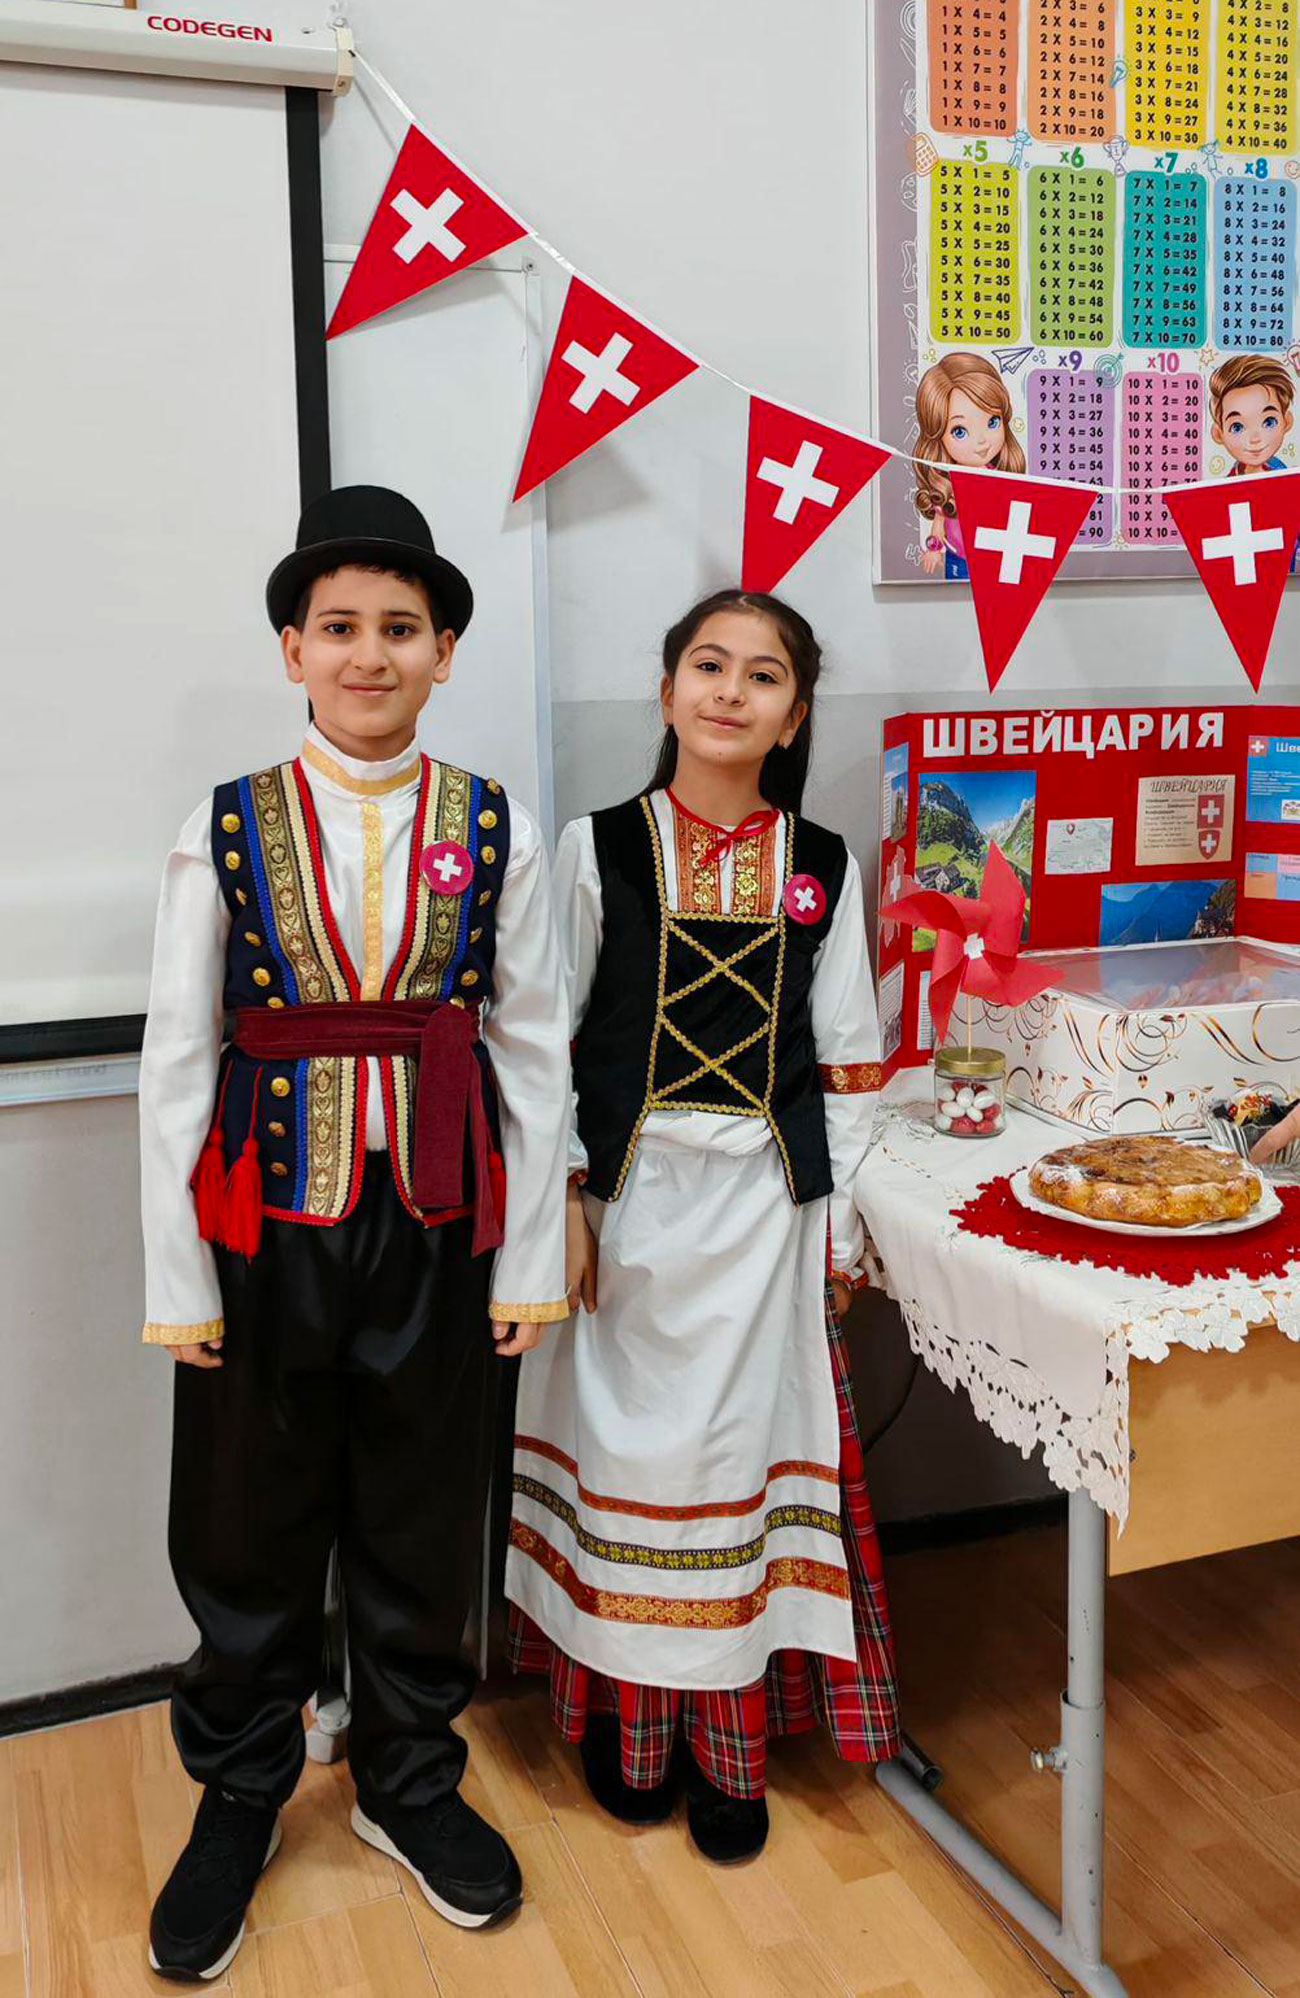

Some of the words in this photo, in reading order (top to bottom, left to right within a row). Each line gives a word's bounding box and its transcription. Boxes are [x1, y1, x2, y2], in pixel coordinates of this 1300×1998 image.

[147, 15, 273, 42] CODEGEN
[1228, 15, 1234, 25] 4
[1255, 17, 1261, 28] 3
[1276, 20, 1288, 30] 12
[973, 27, 980, 38] 5
[1000, 29, 1006, 40] 5
[1136, 24, 1142, 34] 3
[1165, 27, 1172, 37] 4
[1187, 29, 1199, 40] 12
[1040, 33, 1047, 44] 2
[1070, 36, 1076, 46] 5
[1092, 38, 1104, 48] 10
[1227, 67, 1234, 77] 4
[1254, 69, 1260, 80] 6
[1274, 71, 1287, 81] 24
[974, 81, 980, 92] 8
[999, 83, 1006, 94] 8
[1136, 76, 1142, 87] 3
[1165, 79, 1172, 89] 7
[1186, 81, 1198, 92] 21
[1040, 87, 1047, 98] 2
[1069, 89, 1076, 100] 8
[1091, 91, 1104, 102] 16
[968, 118, 980, 128] 10
[995, 119, 998, 130] 10
[1040, 122, 1047, 133] 2
[1064, 124, 1076, 135] 10
[1090, 126, 1104, 137] 20
[1135, 129, 1141, 140] 3
[1160, 131, 1171, 142] 10
[1184, 132, 1198, 144] 30
[1226, 135, 1233, 146] 4
[1249, 137, 1260, 147] 10
[1274, 138, 1287, 149] 40
[941, 184, 947, 194] 5
[974, 186, 980, 196] 2
[997, 187, 1010, 198] 10
[1134, 195, 1141, 206] 7
[1164, 198, 1171, 208] 2
[1184, 198, 1198, 210] 14
[1040, 207, 1046, 218] 6
[1069, 209, 1075, 220] 3
[1091, 210, 1104, 221] 18
[1224, 217, 1231, 228] 8
[1252, 218, 1258, 229] 3
[1272, 220, 1285, 230] 24
[941, 237, 948, 248] 5
[974, 239, 980, 250] 5
[996, 240, 1010, 251] 25
[1040, 260, 1046, 270] 6
[1068, 261, 1075, 272] 6
[1090, 262, 1103, 273] 36
[1224, 268, 1230, 278] 8
[1251, 269, 1258, 279] 6
[1271, 270, 1284, 280] 48
[942, 290, 948, 300] 5
[974, 292, 980, 302] 8
[996, 292, 1010, 304] 40
[1133, 298, 1140, 309] 7
[1163, 299, 1170, 310] 8
[1182, 299, 1196, 310] 56
[1040, 312, 1047, 322] 6
[1068, 312, 1075, 323] 9
[1090, 314, 1103, 324] 54
[1223, 318, 1230, 328] 8
[1250, 319, 1256, 329] 9
[1270, 319, 1284, 330] 72
[1040, 392, 1046, 402] 9
[1069, 393, 1076, 403] 2
[1090, 393, 1102, 404] 18
[1128, 395, 1140, 405] 10
[1162, 396, 1168, 406] 2
[1185, 396, 1198, 406] 20
[1040, 426, 1047, 436] 9
[1068, 426, 1076, 437] 4
[1090, 427, 1103, 438] 36
[1128, 445, 1140, 455] 10
[1162, 445, 1168, 455] 5
[1185, 445, 1198, 456] 50
[1040, 460, 1047, 471] 9
[1069, 460, 1076, 470] 6
[1090, 460, 1103, 471] 54
[923, 710, 1224, 760] ШВЕЙЦАРИЯ
